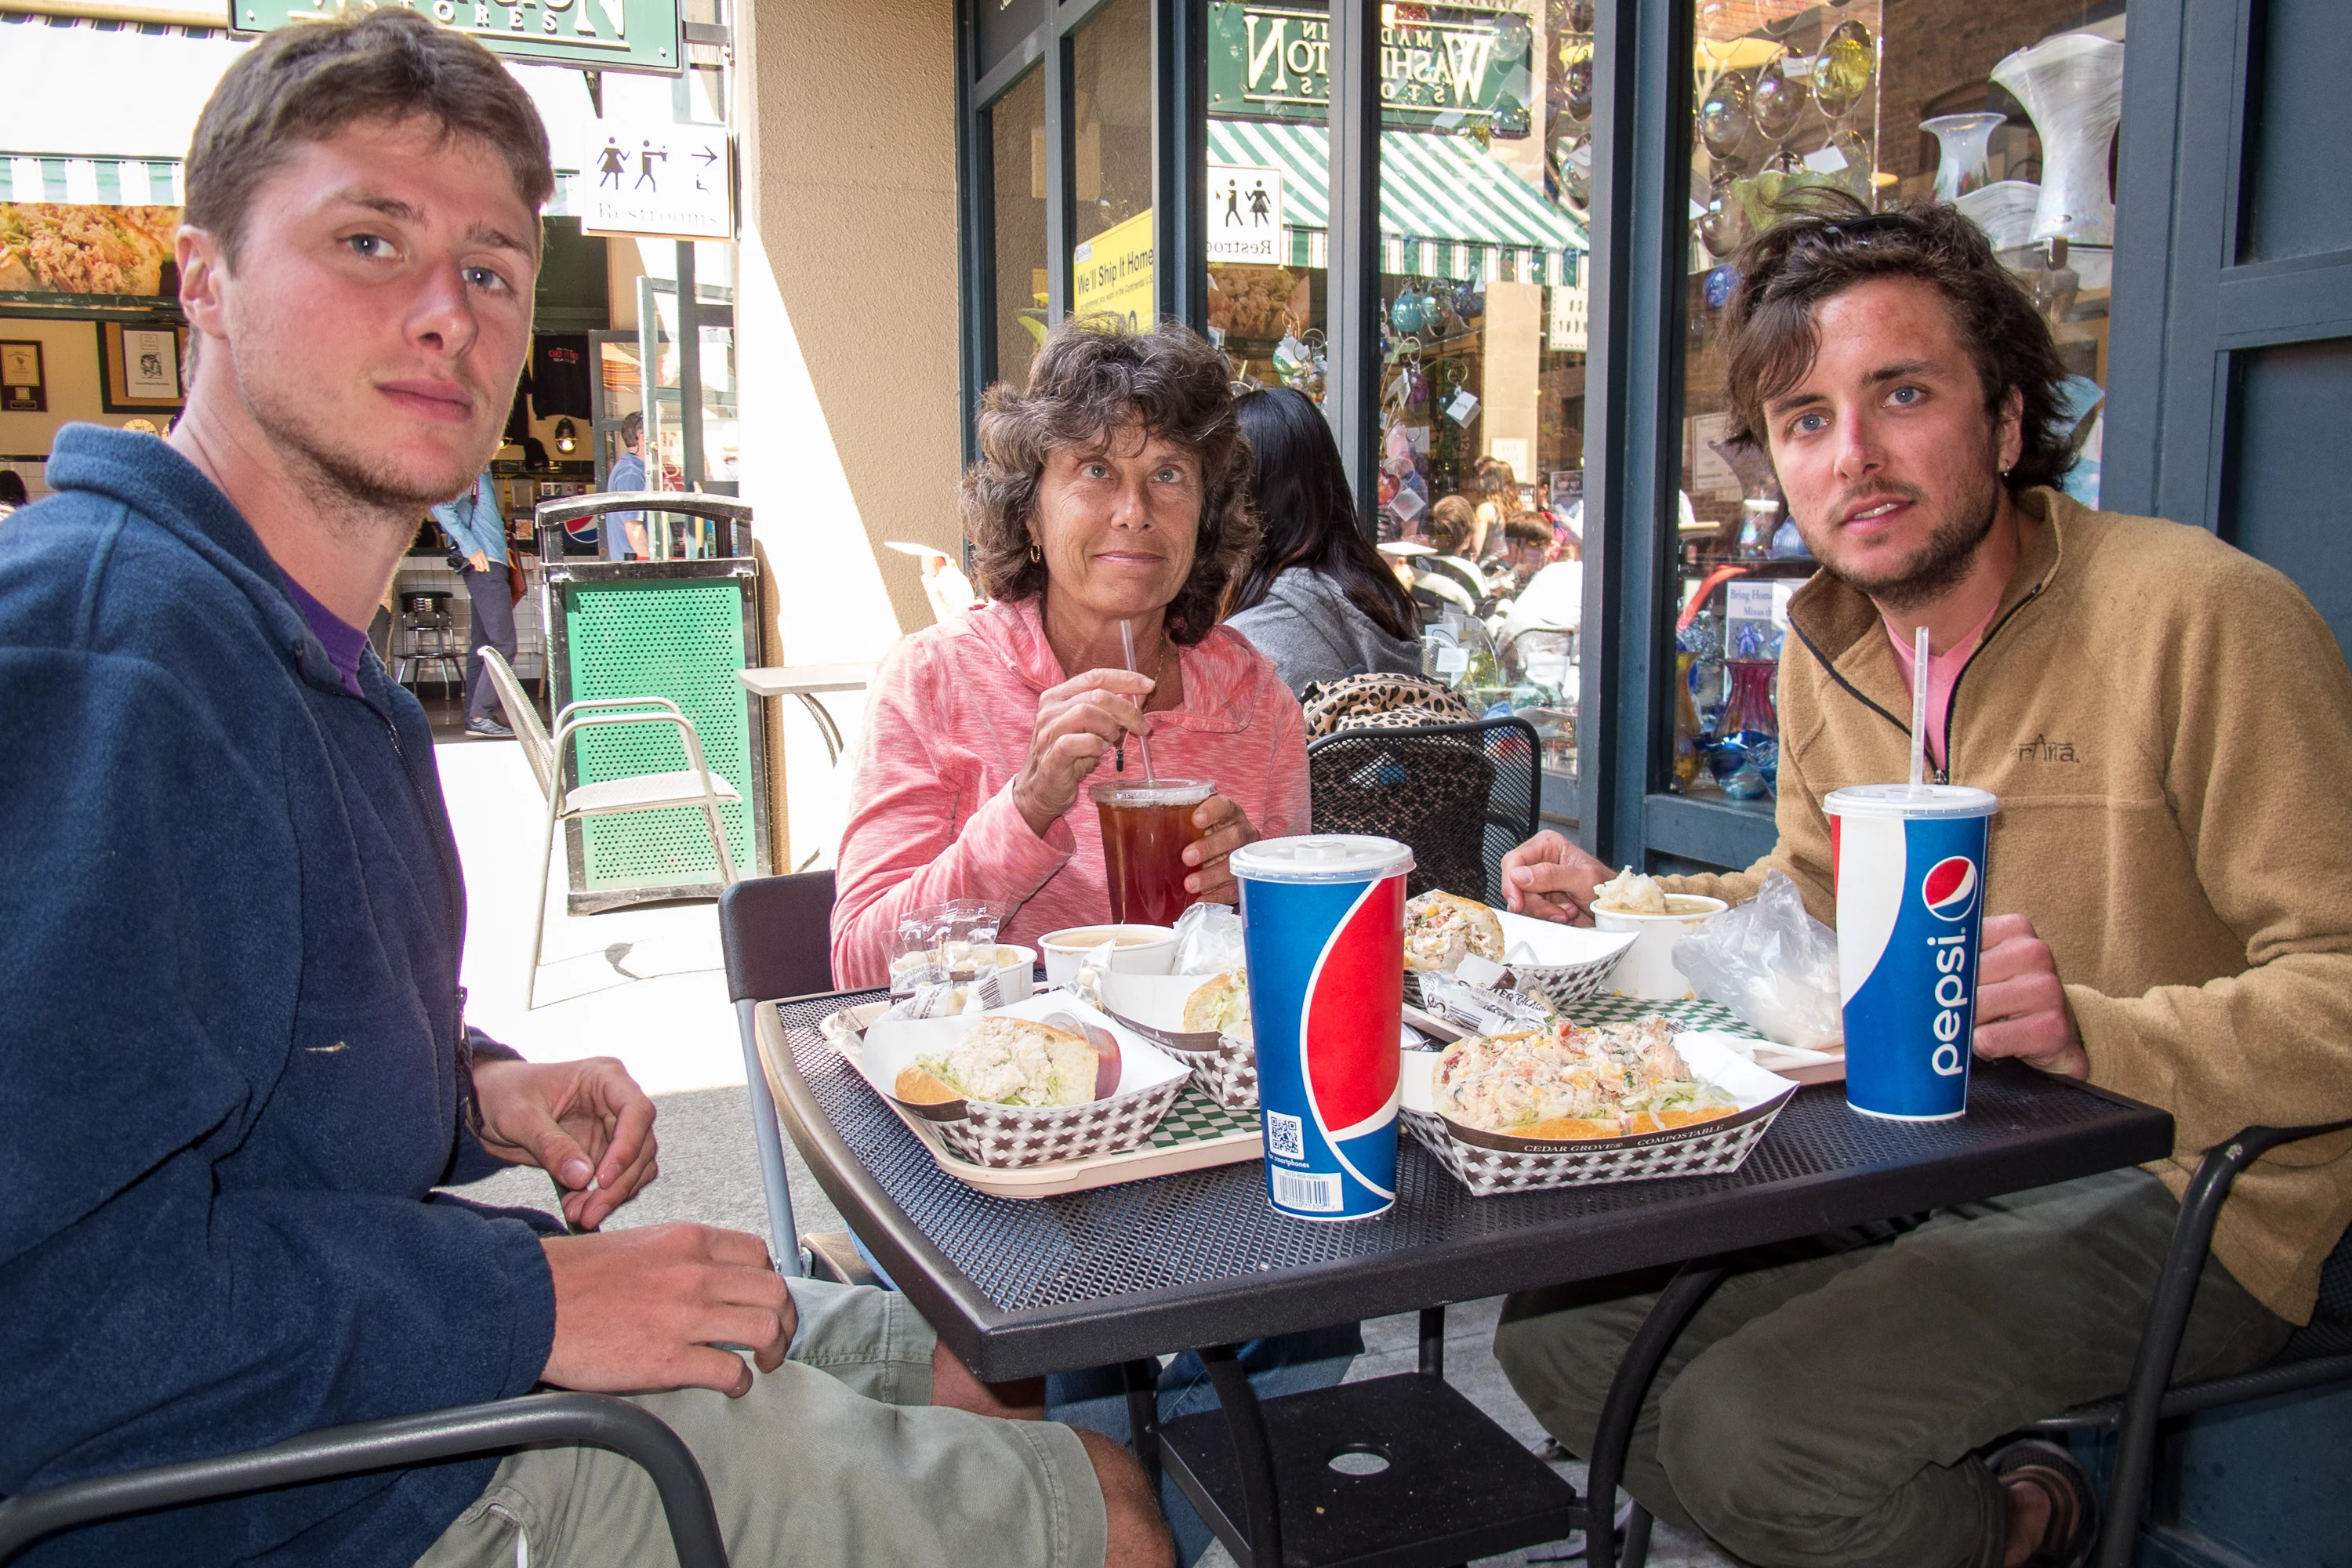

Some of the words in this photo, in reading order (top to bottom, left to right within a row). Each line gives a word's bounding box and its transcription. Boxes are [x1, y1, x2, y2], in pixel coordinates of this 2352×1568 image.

[1078, 268, 1096, 296] We'll
[1098, 260, 1117, 287] Ship
[1120, 256, 1125, 278] It
[1127, 248, 1153, 275] Home
[1524, 1144, 1567, 1152] CEDAR
[1637, 1123, 1725, 1146] COMPOSTABLE
[1274, 1156, 1309, 1168] smartphones
